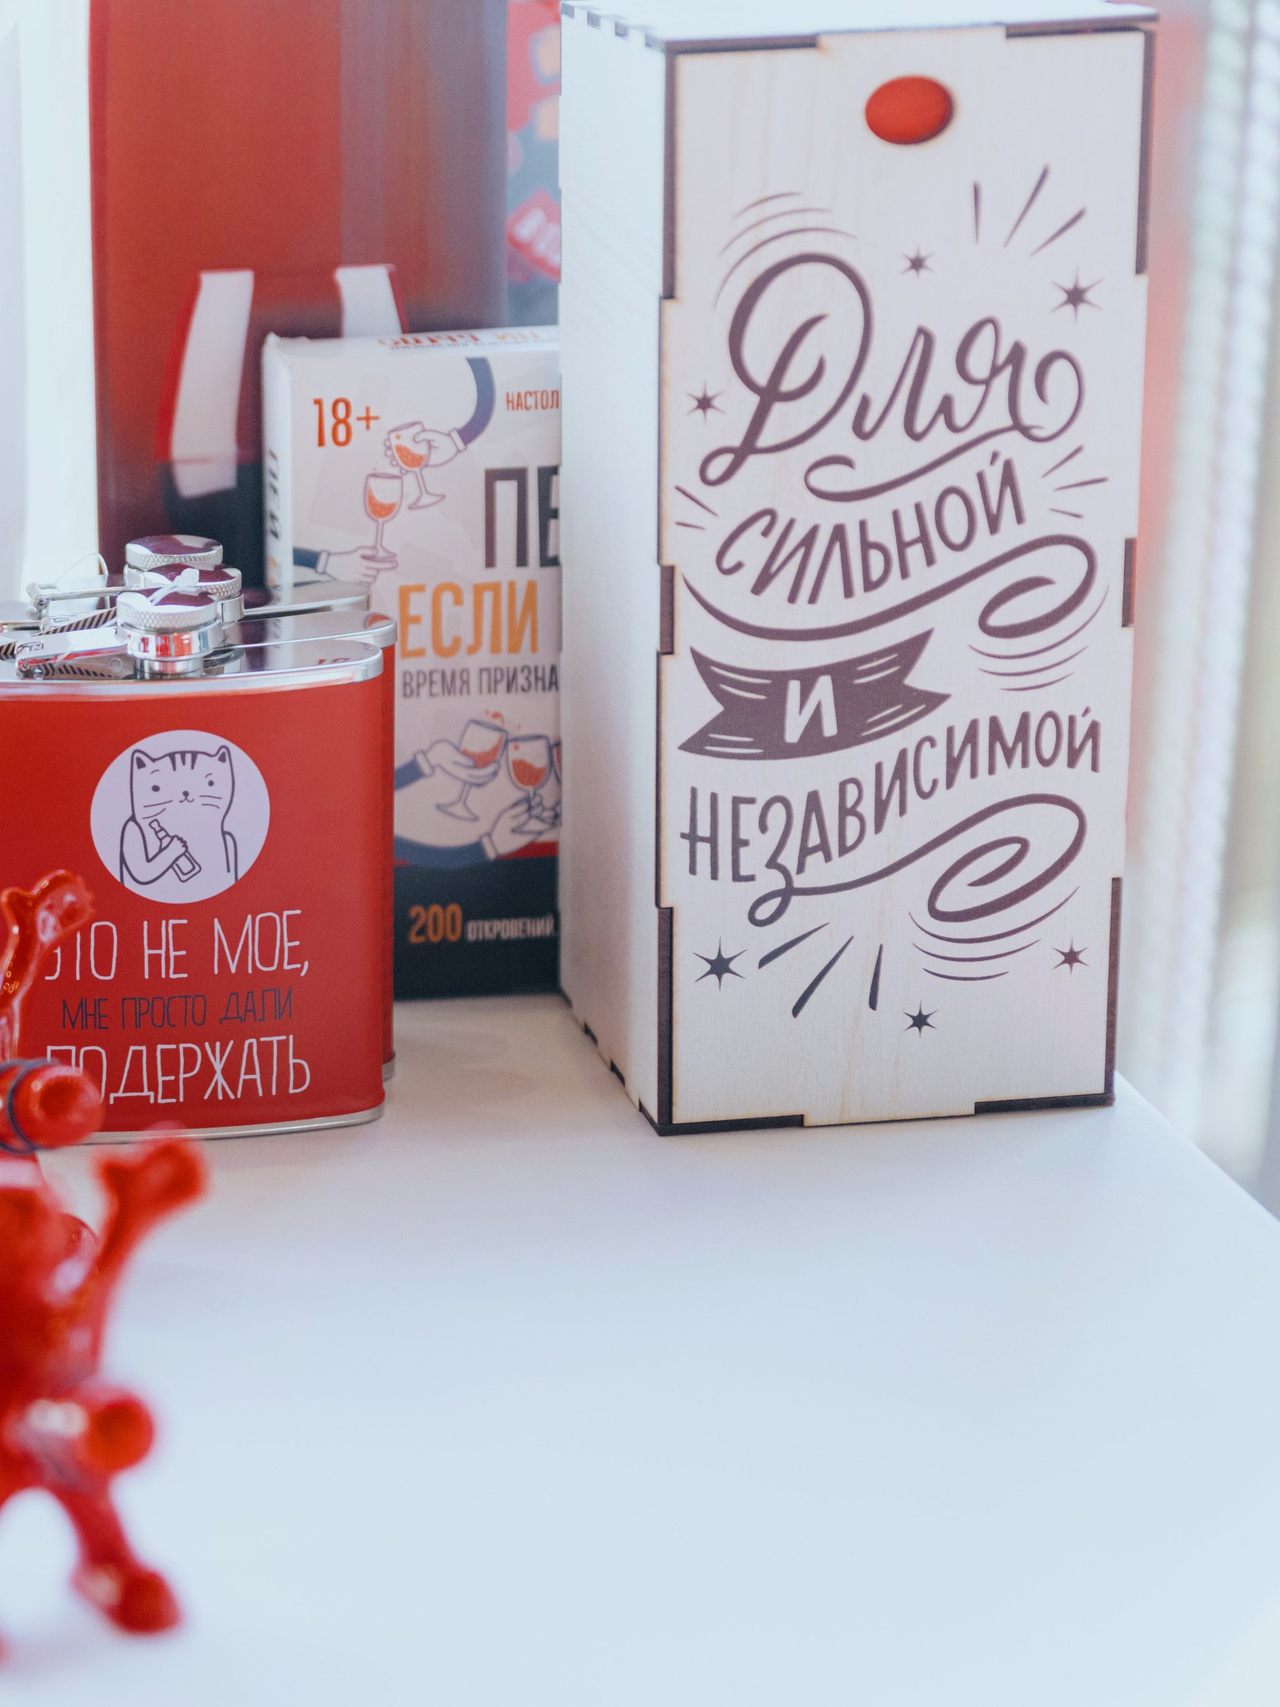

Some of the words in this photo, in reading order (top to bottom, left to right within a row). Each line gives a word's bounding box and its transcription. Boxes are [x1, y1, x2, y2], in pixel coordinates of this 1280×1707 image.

[699, 252, 1086, 501] Для
[314, 397, 380, 447] 18+
[715, 450, 1026, 605] СИЛЬНОЙ
[398, 580, 539, 659] ЕСЛИ
[403, 667, 470, 699] ВРЕМЯ
[784, 674, 837, 744] И
[680, 705, 1102, 927] НЕЗАВИСИМОЙ
[144, 919, 188, 980] НЕ
[214, 910, 309, 976] МОЕ,
[408, 902, 462, 944] 200
[62, 997, 109, 1030] МНЕ
[121, 993, 207, 1029] ПРОСТО
[219, 986, 293, 1024] ДАЛИ
